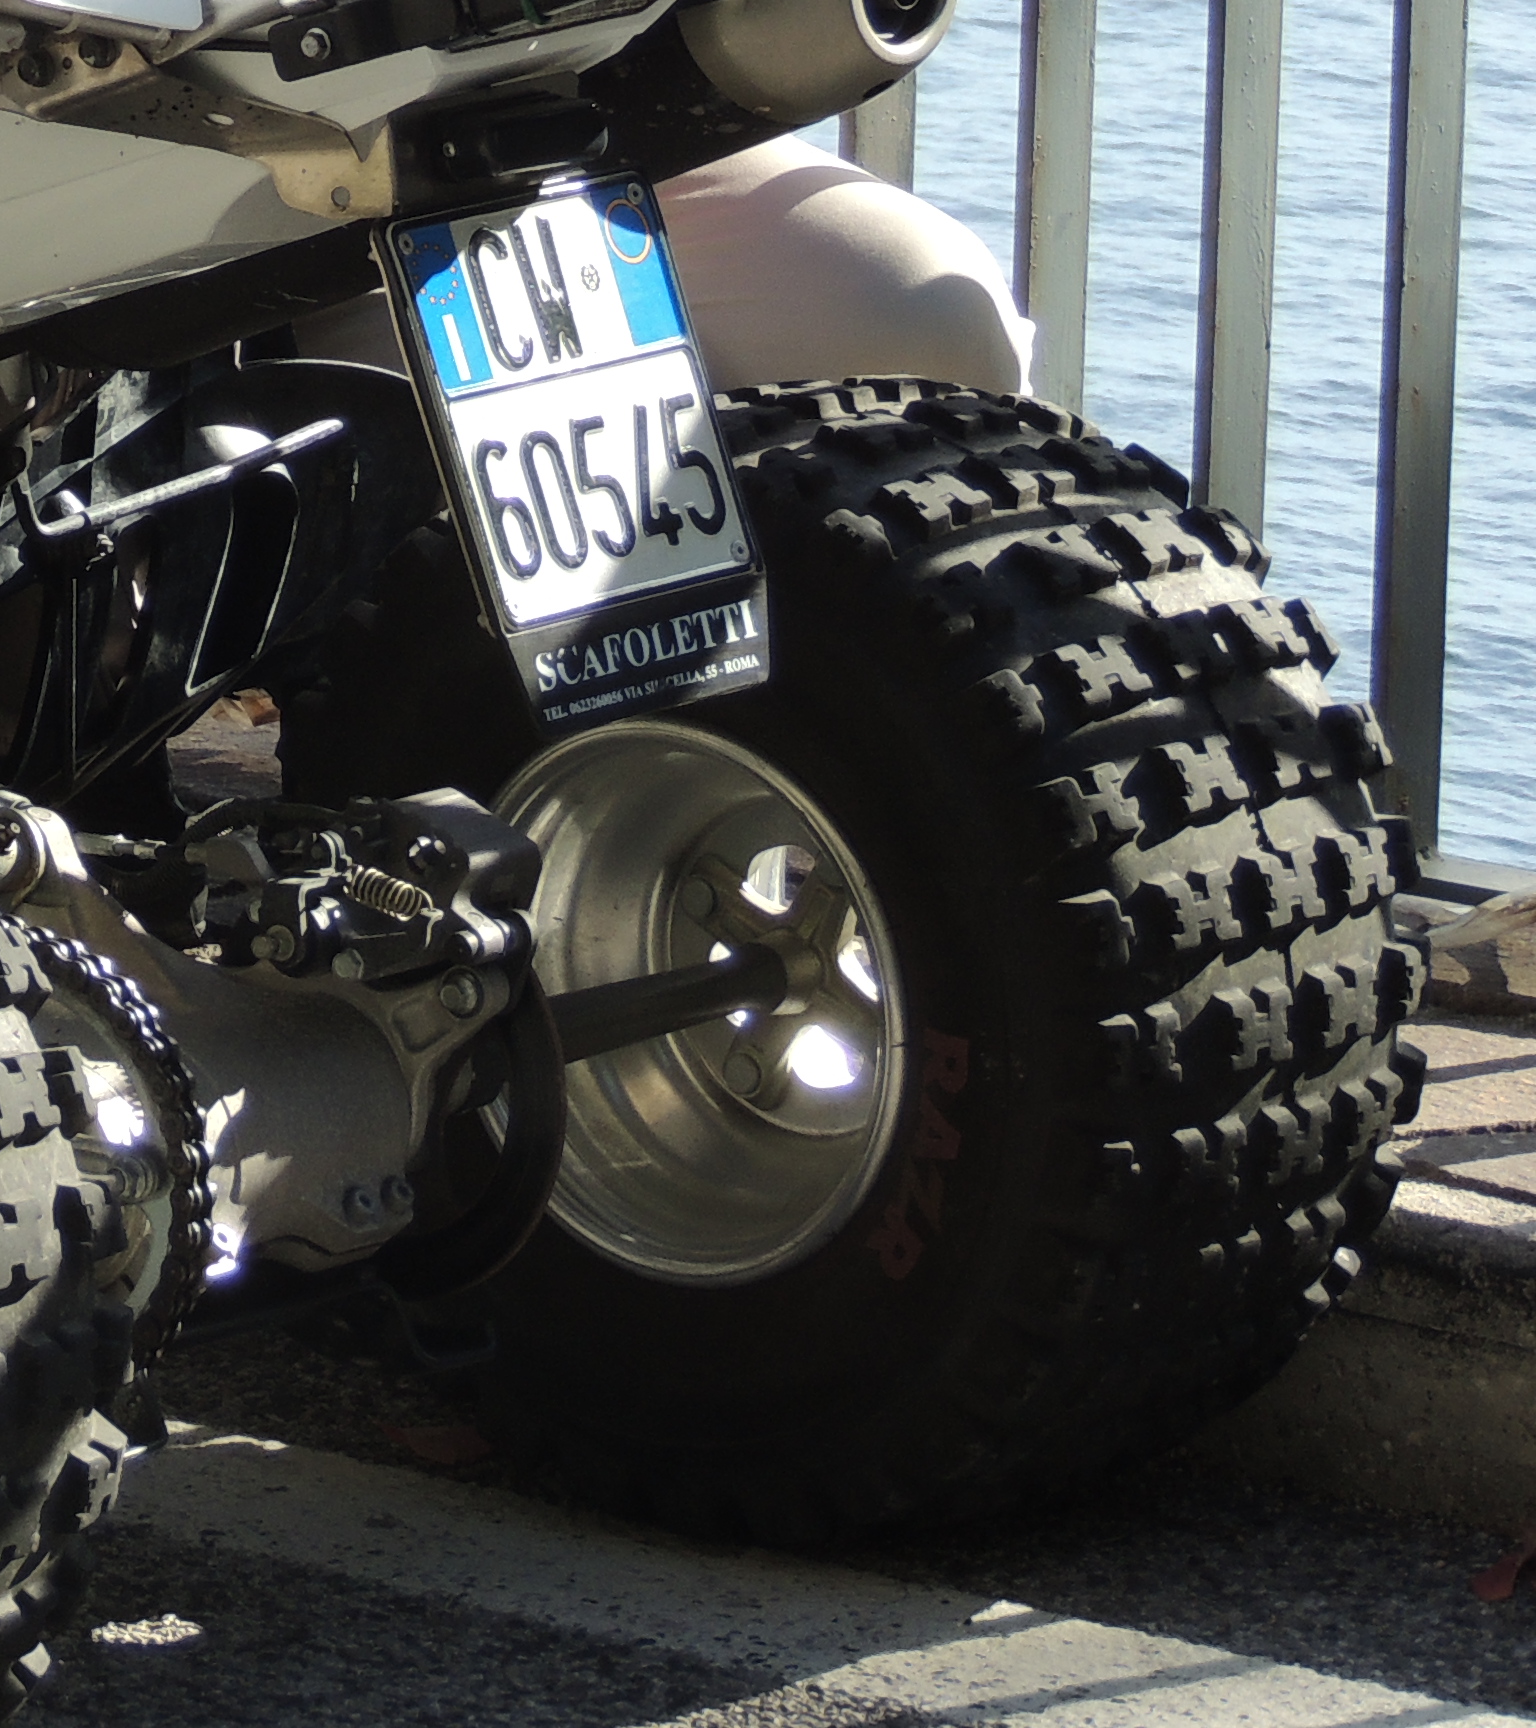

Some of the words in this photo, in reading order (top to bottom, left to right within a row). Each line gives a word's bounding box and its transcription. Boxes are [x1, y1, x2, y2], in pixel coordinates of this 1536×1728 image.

[467, 216, 583, 372] CW
[441, 313, 472, 381] I
[471, 394, 727, 581] 60545
[535, 599, 759, 692] SCAFOLETTI
[625, 683, 643, 699] VIA
[723, 654, 760, 675] ROMA
